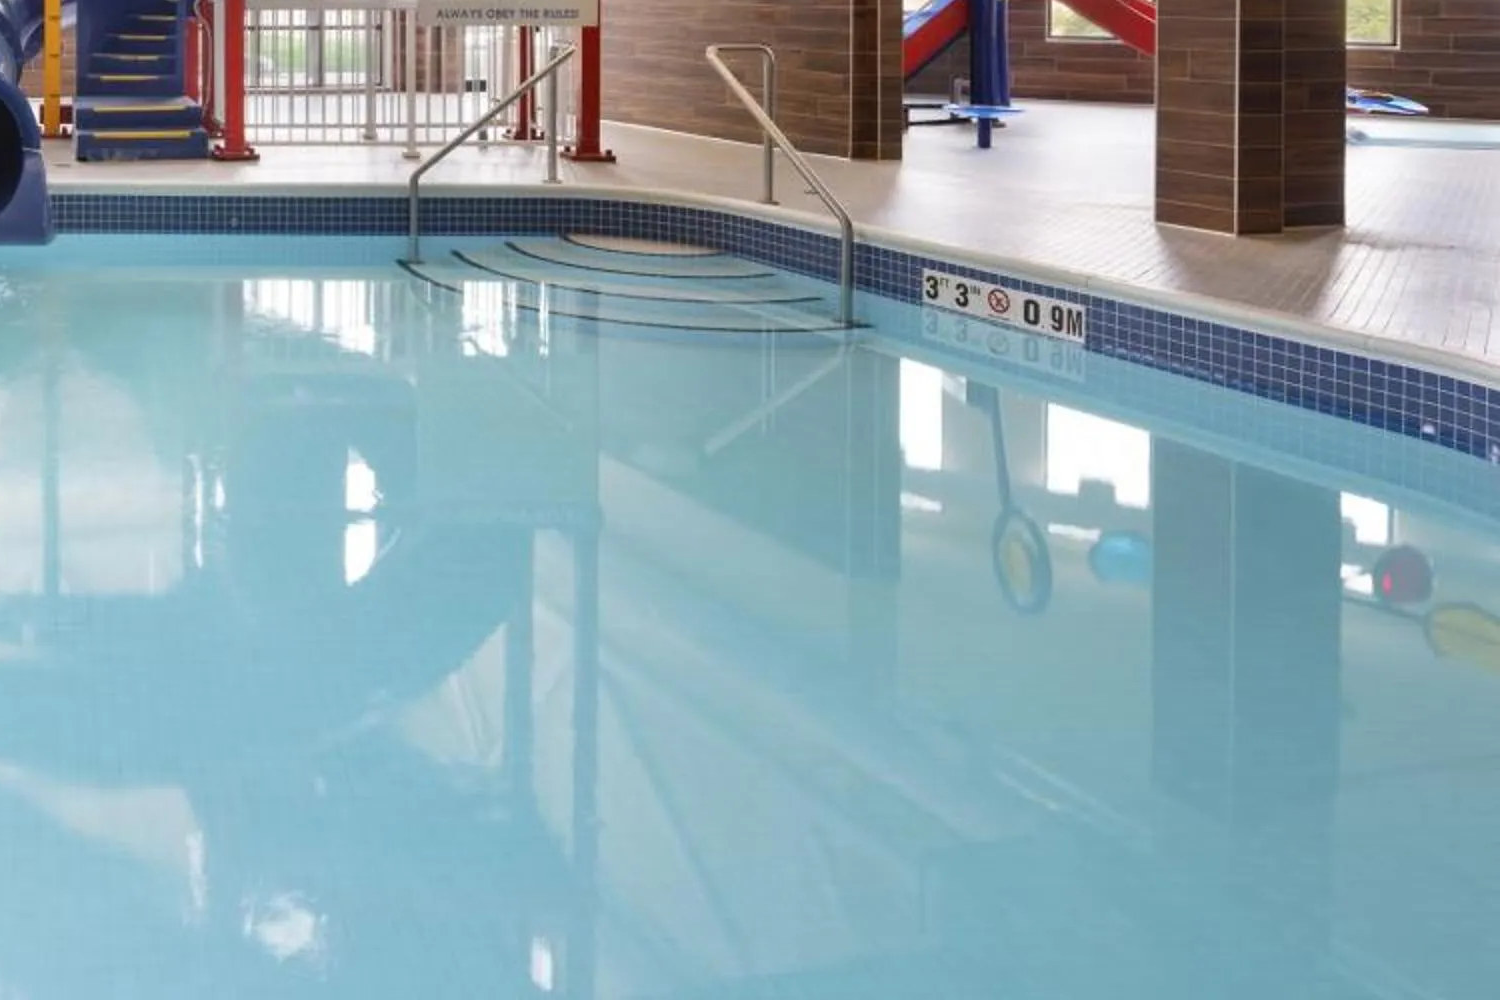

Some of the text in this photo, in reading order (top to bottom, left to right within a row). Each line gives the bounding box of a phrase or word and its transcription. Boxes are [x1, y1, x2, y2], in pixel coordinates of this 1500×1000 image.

[436, 8, 482, 19] ALWAYS
[486, 8, 515, 19] OBEY
[520, 8, 539, 19] THE
